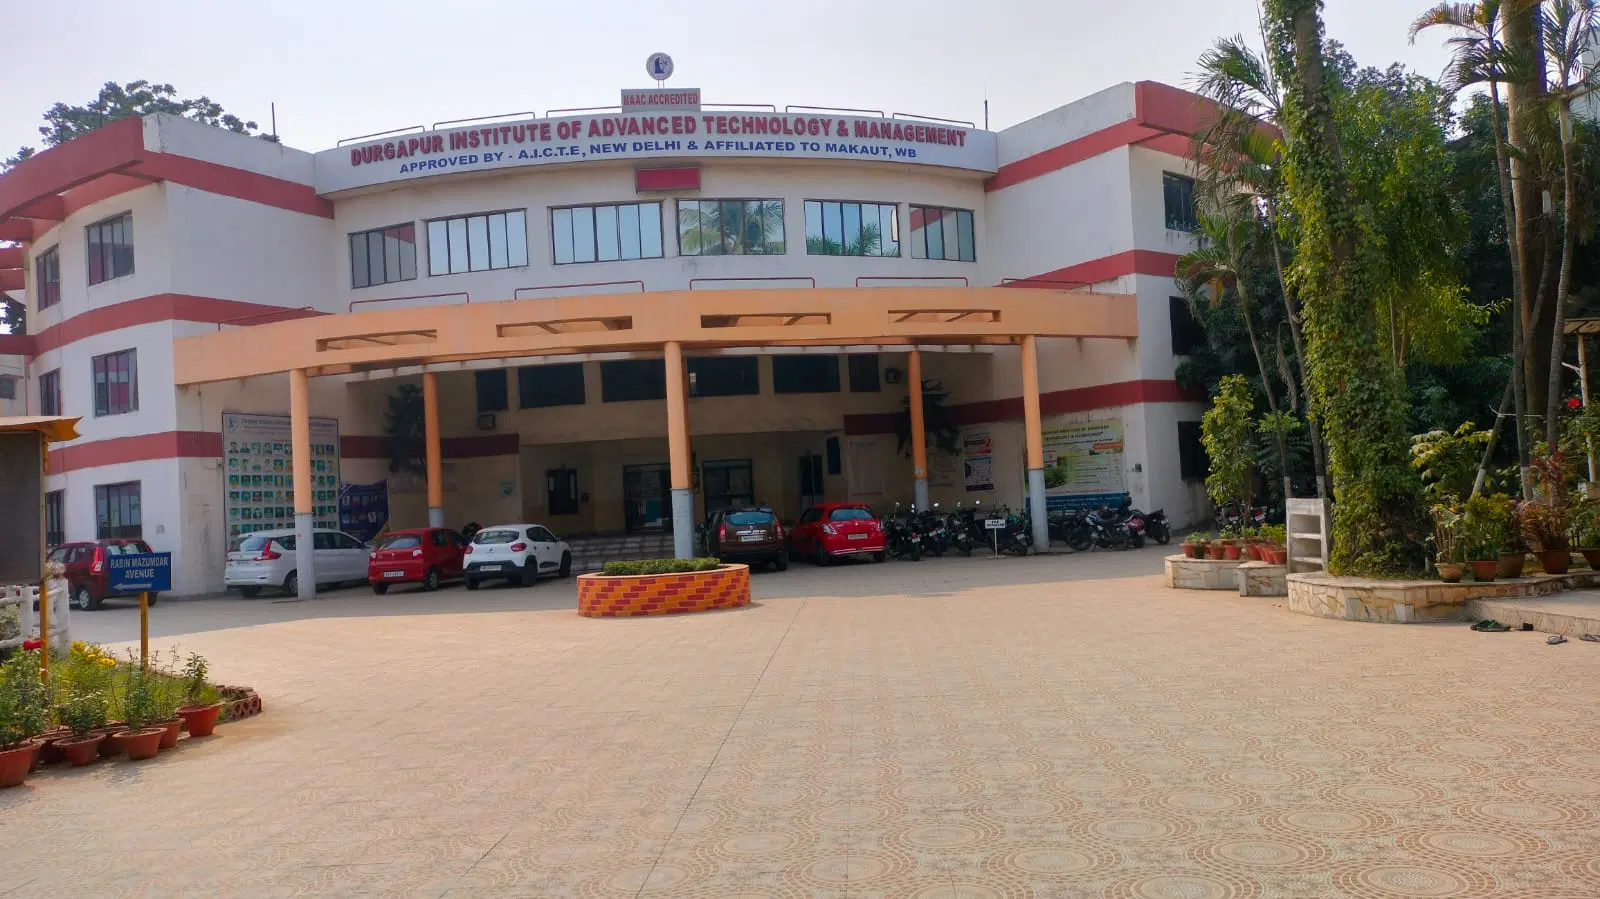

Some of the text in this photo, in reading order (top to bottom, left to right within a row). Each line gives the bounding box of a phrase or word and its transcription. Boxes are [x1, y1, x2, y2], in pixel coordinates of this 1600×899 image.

[624, 92, 698, 105] NAAC ACCREDITED
[351, 115, 967, 166] DURGAPUR INSTITUTE OF ADVANCED TECHNOLOGY & MANAGEMENT
[400, 154, 479, 174] APPROVED
[483, 151, 503, 164] BY
[590, 143, 628, 154] NEW
[632, 140, 681, 152] DELHI
[687, 141, 699, 151] &
[703, 140, 796, 151] AFFILIATED
[801, 141, 821, 151] TO
[825, 143, 892, 159] MAKAUT,
[895, 148, 917, 158] WB
[132, 557, 168, 568] MAZUMDAR
[125, 569, 154, 578] AVENUE
